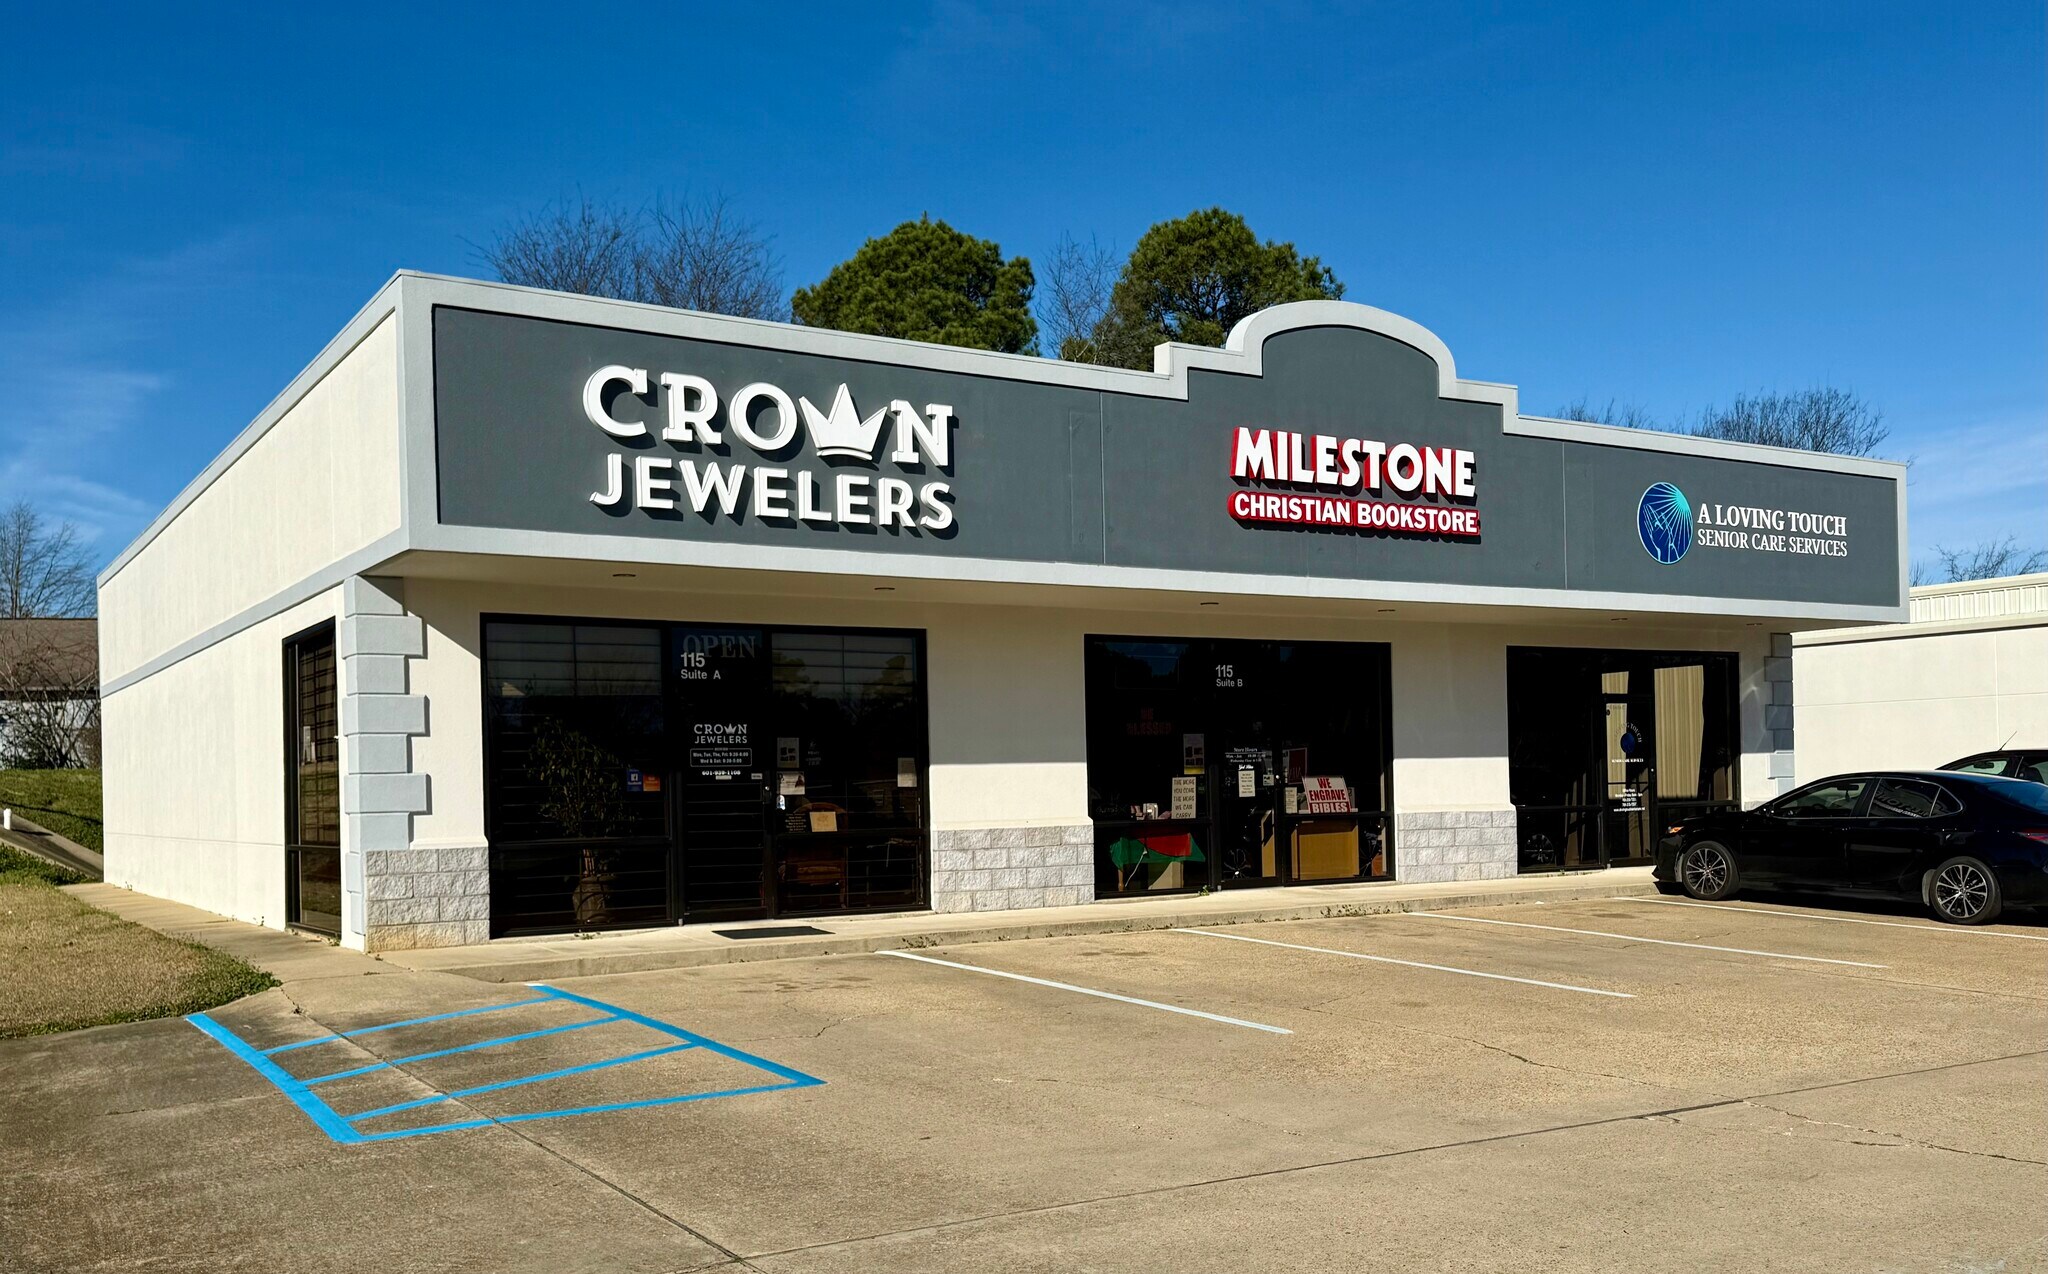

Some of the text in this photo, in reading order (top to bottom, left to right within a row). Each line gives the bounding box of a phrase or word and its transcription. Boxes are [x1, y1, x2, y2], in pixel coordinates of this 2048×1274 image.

[1230, 426, 1477, 498] MILESTONE
[589, 452, 954, 530] JEWELERS
[1233, 493, 1478, 533] CHRISTIAN BOOKSTORE
[1697, 503, 1848, 537] A LOVING TOUCH
[1697, 528, 1848, 557] SENIOR CARE SERVICES
[682, 634, 757, 659] OPEN
[680, 651, 706, 668] 115
[680, 669, 722, 680] Suite A
[1215, 664, 1234, 678] 115
[1215, 678, 1244, 688] Suite B
[694, 735, 748, 744] JEWELERS
[1317, 778, 1332, 789] WE
[1308, 789, 1347, 801] ENGRAVE
[1311, 802, 1348, 814] BIBLES
